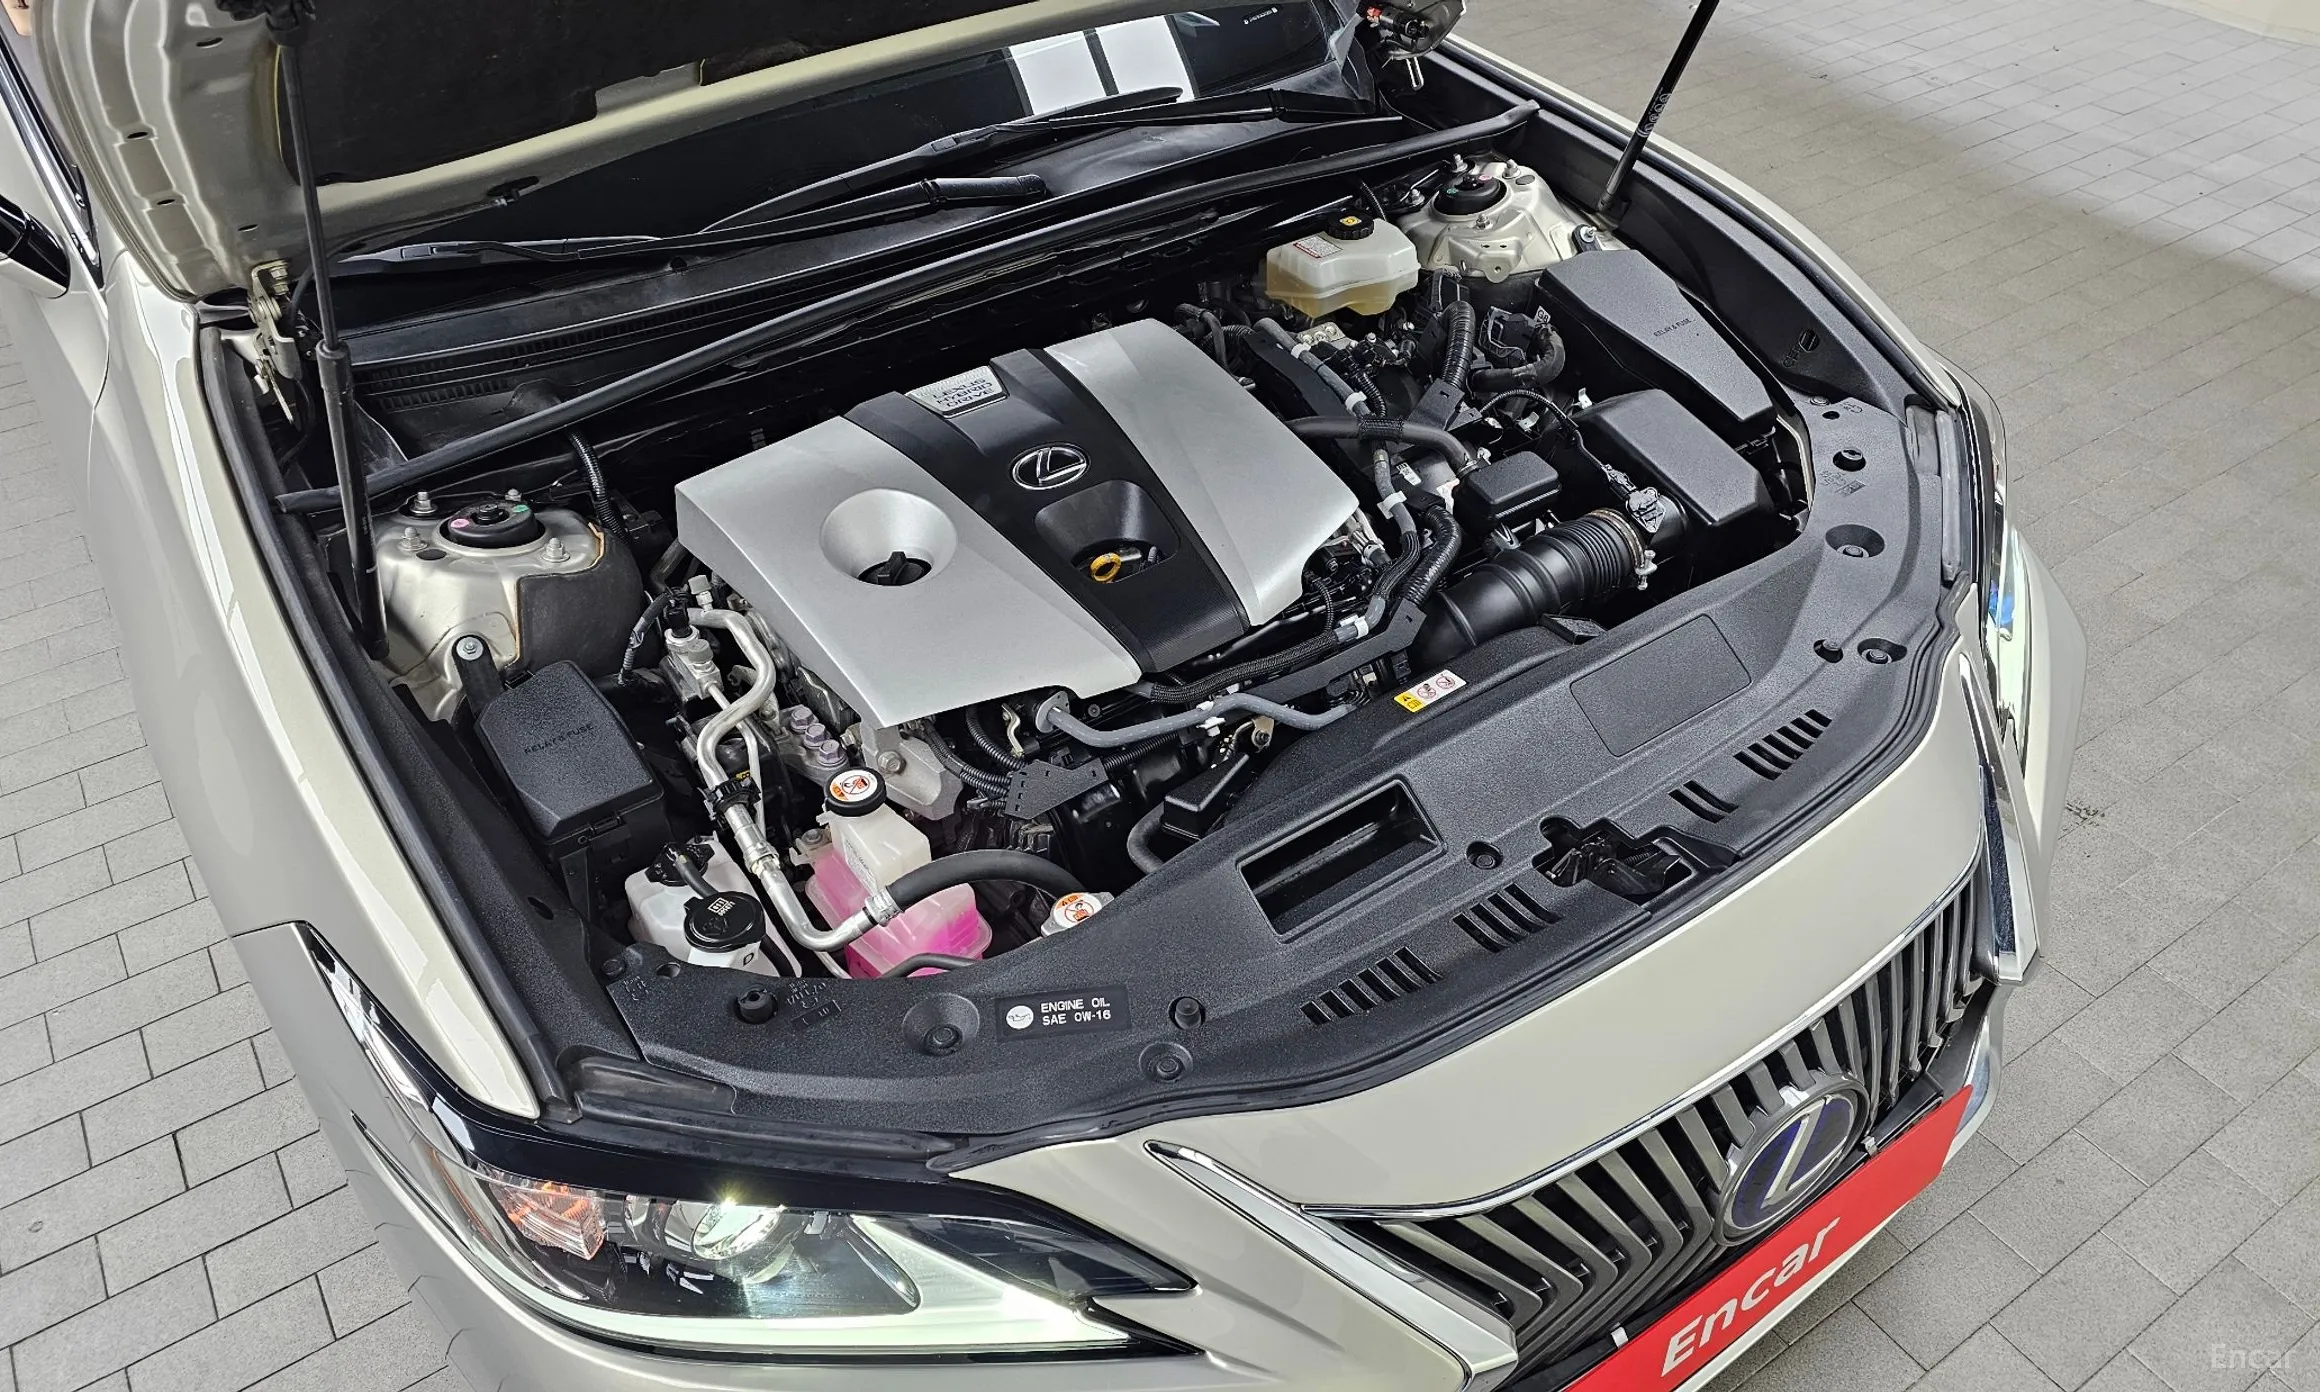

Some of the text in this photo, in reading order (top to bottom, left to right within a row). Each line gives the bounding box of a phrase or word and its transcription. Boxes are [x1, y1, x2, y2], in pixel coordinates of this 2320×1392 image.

[932, 378, 987, 399] LEXUS
[936, 382, 994, 404] HYBRID
[946, 387, 996, 408] DRIVE
[1040, 997, 1111, 1014] ENGINE OIL
[1042, 1013, 1067, 1026] SAE
[1660, 1216, 1841, 1378] Encar
